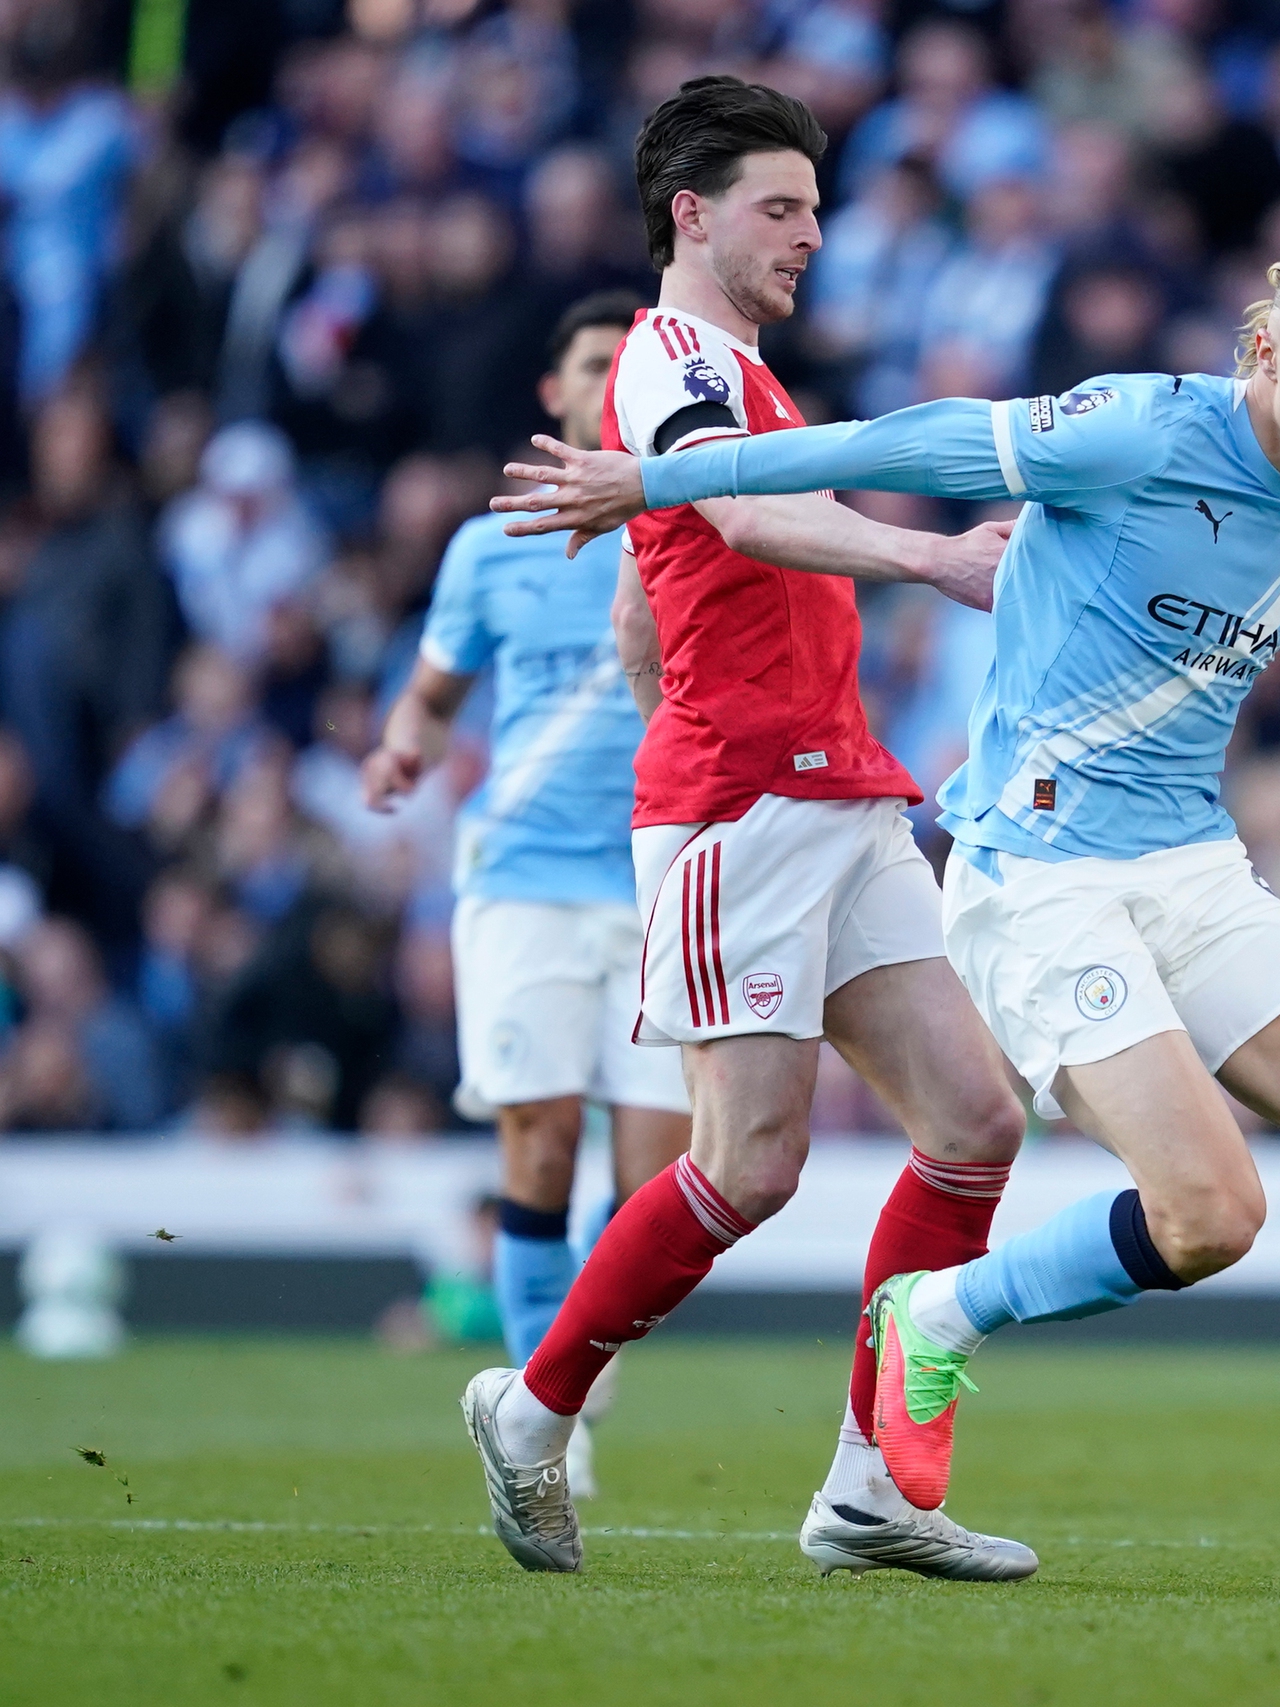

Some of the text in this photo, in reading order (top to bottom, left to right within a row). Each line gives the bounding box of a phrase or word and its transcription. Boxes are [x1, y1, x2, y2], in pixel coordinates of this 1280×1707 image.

[748, 981, 777, 989] Arsenal
[1078, 970, 1113, 1000] MANCHESTER
[1104, 1003, 1118, 1016] CITY
